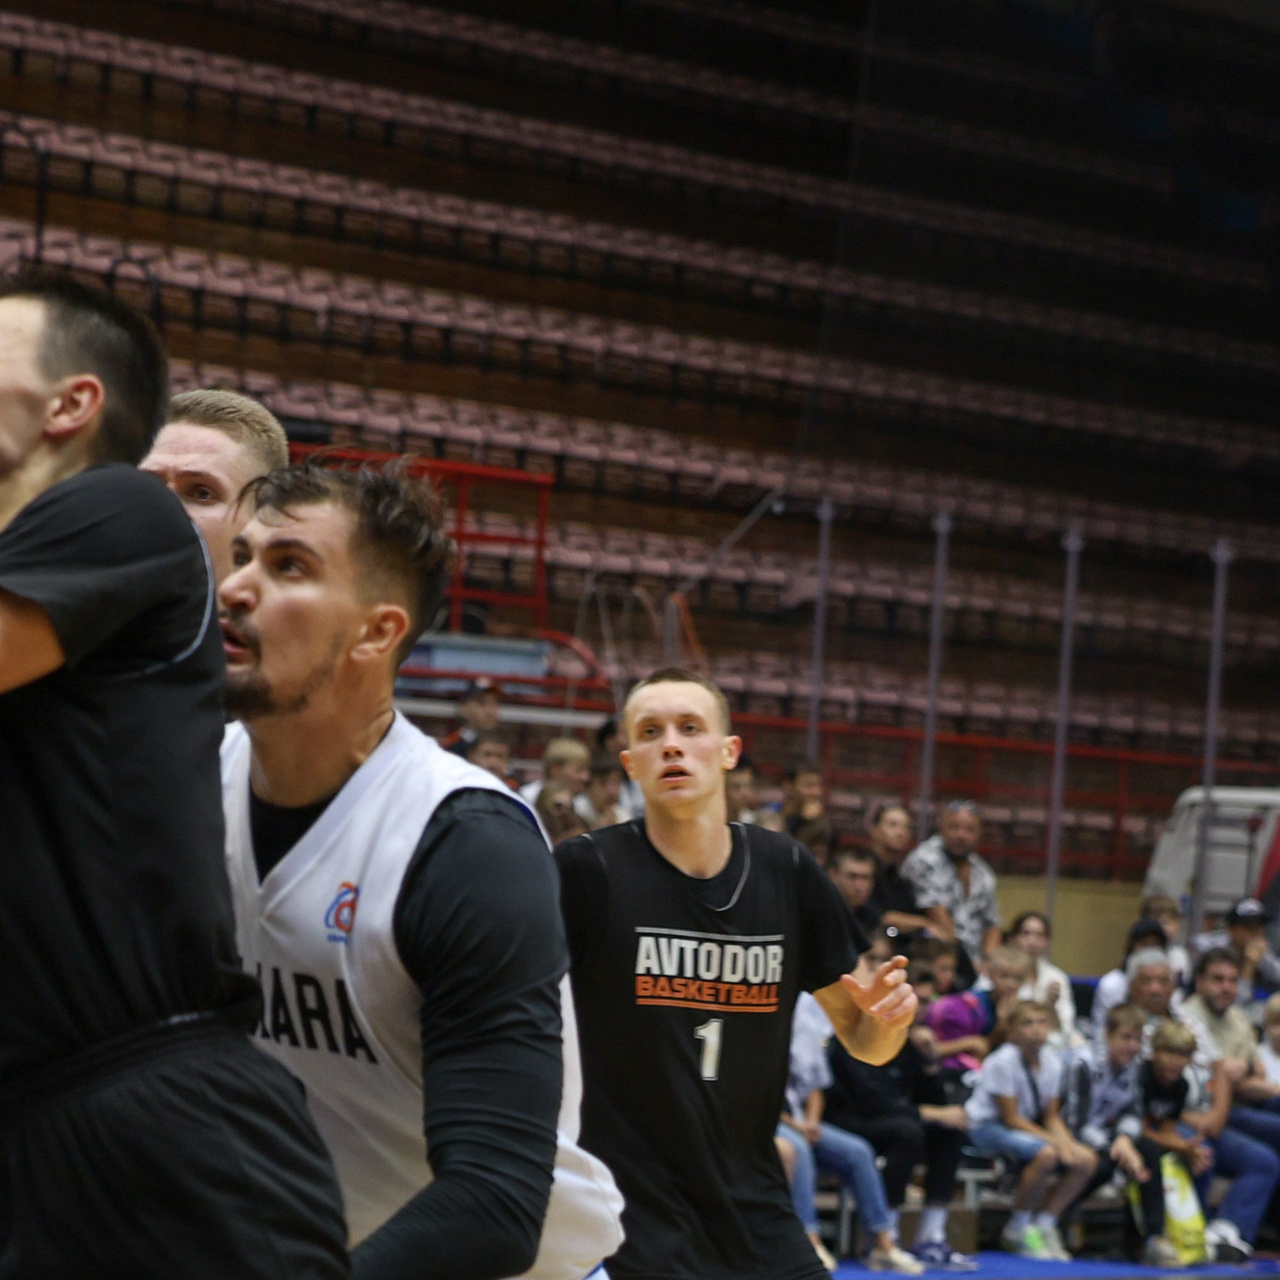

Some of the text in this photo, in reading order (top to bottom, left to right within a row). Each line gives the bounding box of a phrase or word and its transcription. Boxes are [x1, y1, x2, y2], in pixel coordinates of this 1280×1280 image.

[635, 936, 784, 984] AVTODOR
[255, 962, 379, 1065] ARA
[635, 976, 779, 1004] BASKETBALL
[694, 1018, 724, 1081] 1
